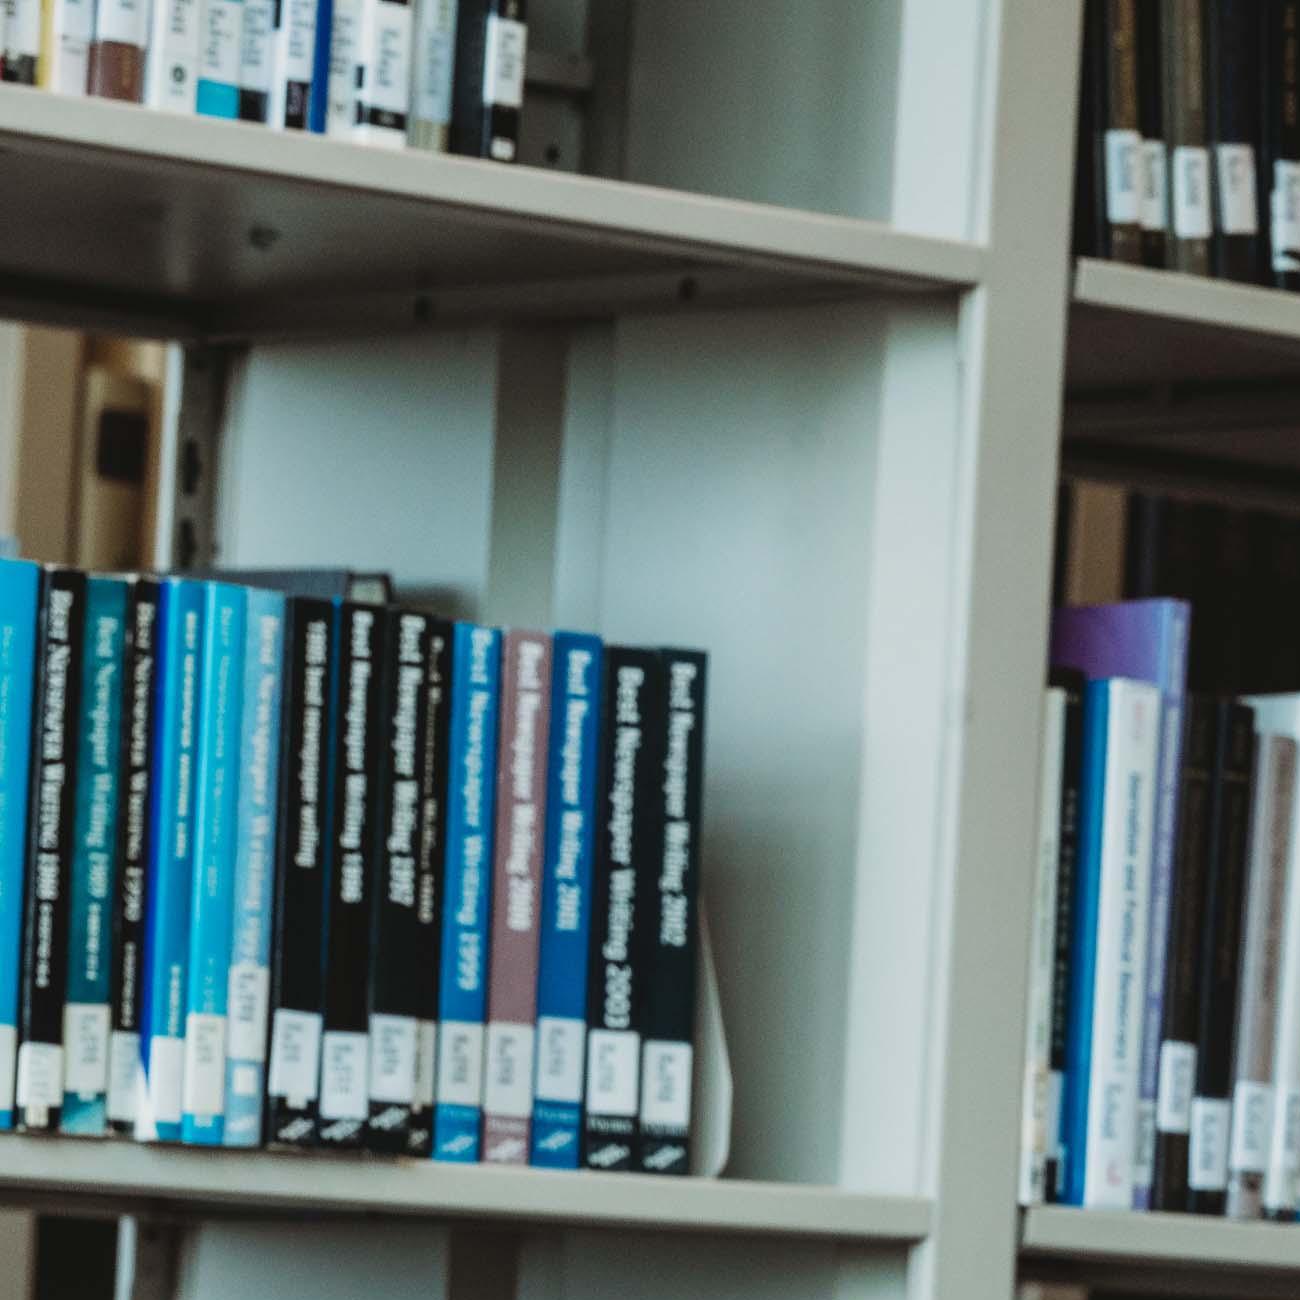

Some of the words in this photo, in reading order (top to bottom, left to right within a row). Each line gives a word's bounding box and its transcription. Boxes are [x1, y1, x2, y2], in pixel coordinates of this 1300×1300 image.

[352, 611, 373, 658] Best
[399, 615, 426, 663] Best
[467, 628, 494, 683] Best
[517, 640, 545, 690] Best
[567, 650, 592, 696] Best
[616, 666, 645, 724] Best
[670, 662, 697, 709] Best
[88, 663, 116, 767] Newspaper
[344, 660, 371, 771] Newspaper
[391, 665, 423, 776] Newspaper
[510, 691, 541, 800] Newspaper
[298, 707, 323, 803] newspaper
[458, 691, 491, 827] Newspaper
[559, 699, 589, 805] Newspaper
[662, 711, 695, 818] Newspaper
[85, 773, 113, 847] Writing
[339, 774, 367, 849] Writing
[387, 780, 418, 853] Writing
[608, 727, 642, 864] Newspaper
[294, 805, 319, 868] writing
[505, 803, 537, 875] Writing
[554, 810, 584, 880] Writing
[657, 821, 690, 892] Writing
[388, 856, 415, 907] 1997
[458, 835, 484, 924] Writing
[602, 870, 636, 961] Writing
[659, 893, 688, 947] 2002
[602, 964, 630, 1028] 2003
